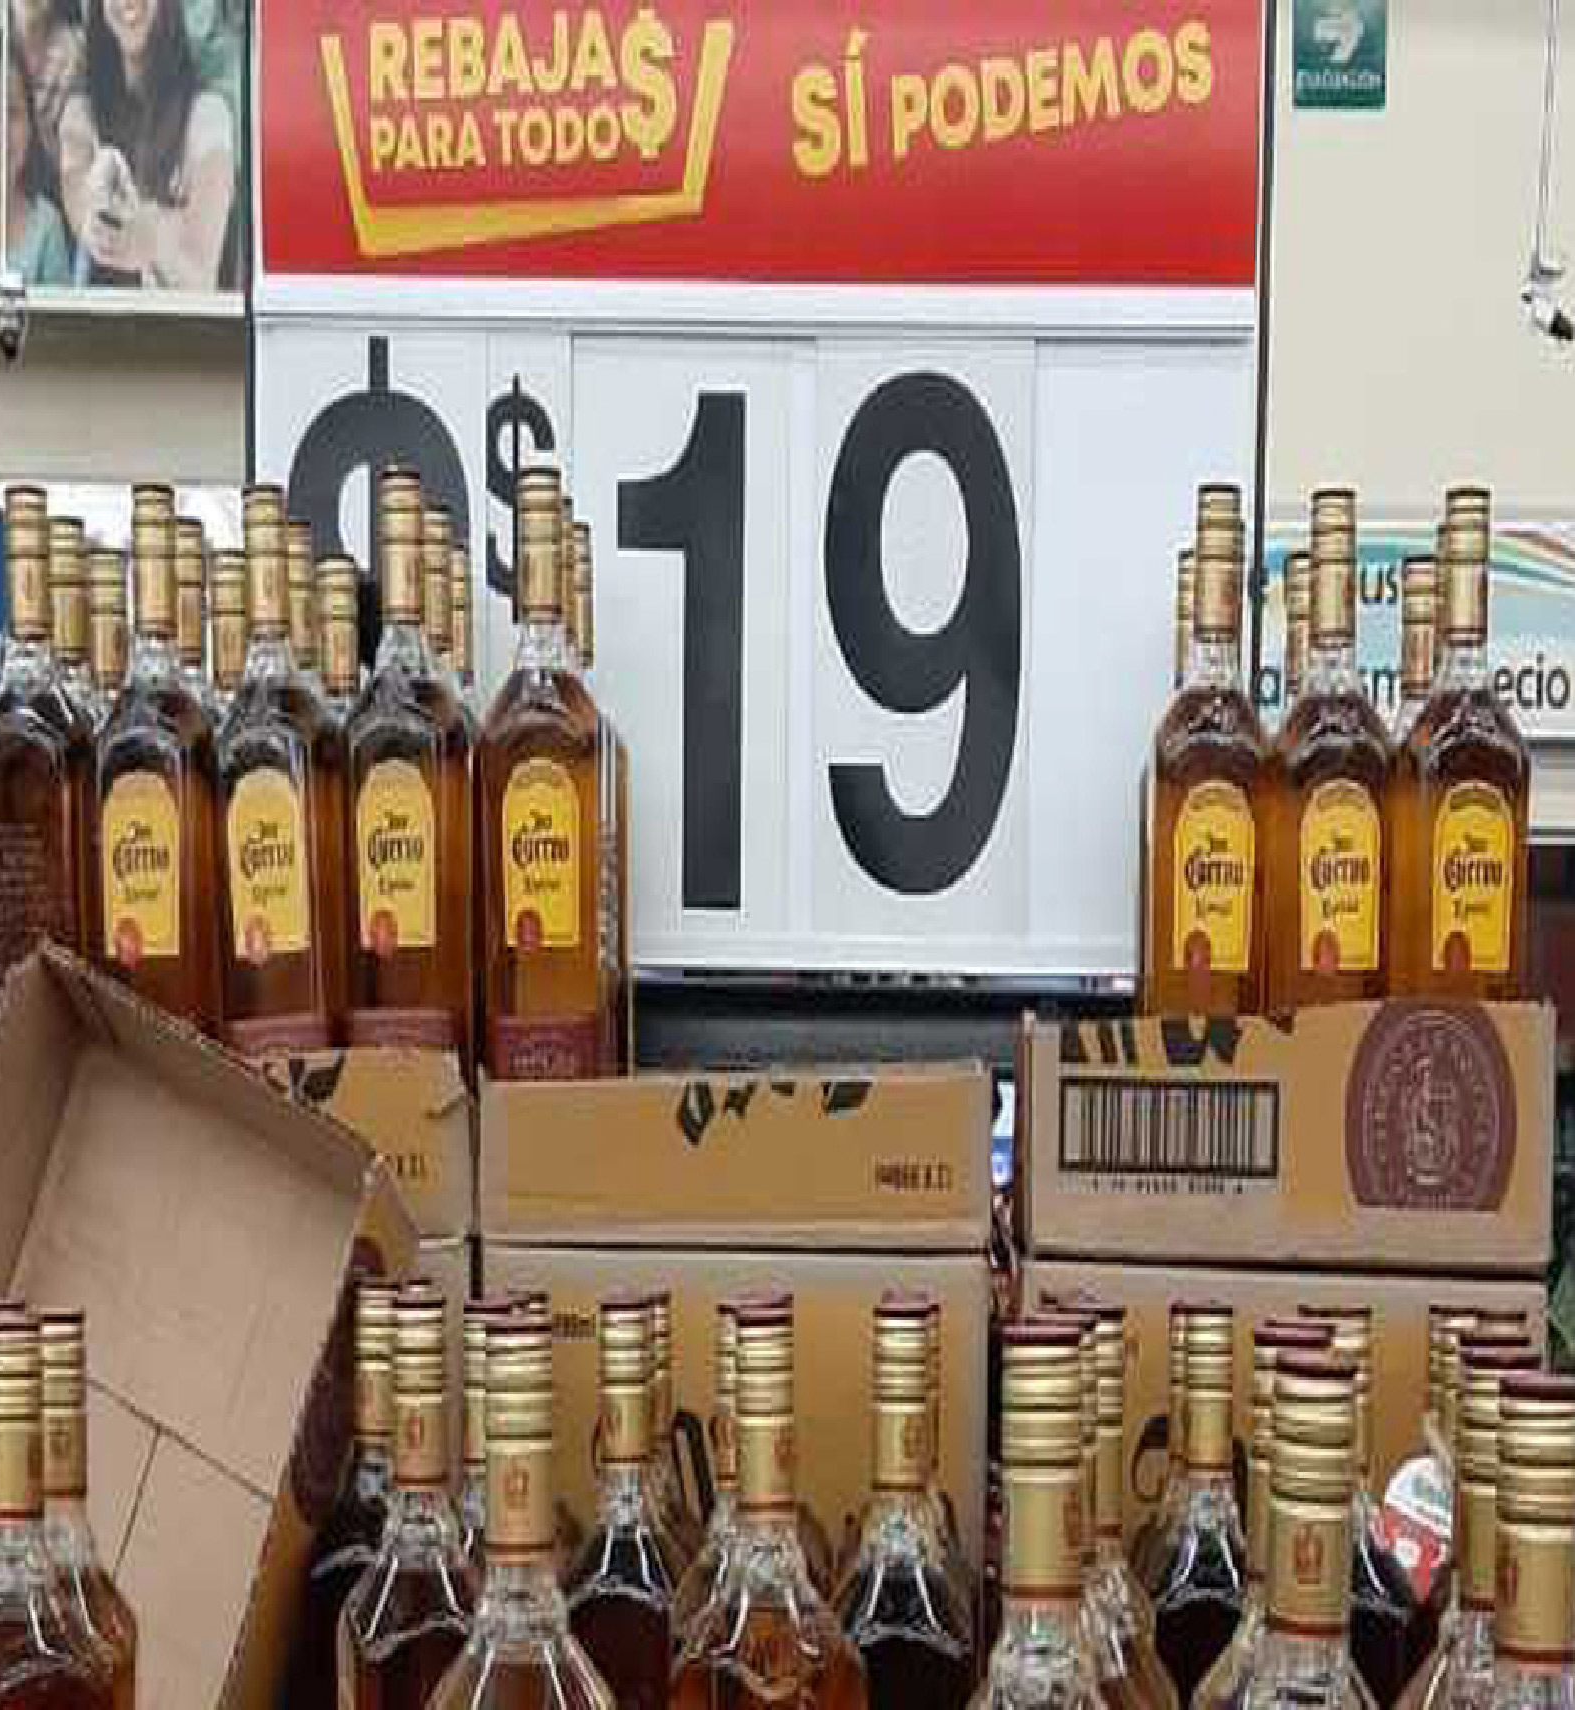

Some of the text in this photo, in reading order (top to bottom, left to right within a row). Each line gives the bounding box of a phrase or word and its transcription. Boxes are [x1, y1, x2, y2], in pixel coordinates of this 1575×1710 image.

[370, 110, 487, 172] PARA
[791, 19, 1214, 177] SÍ PODEMOS
